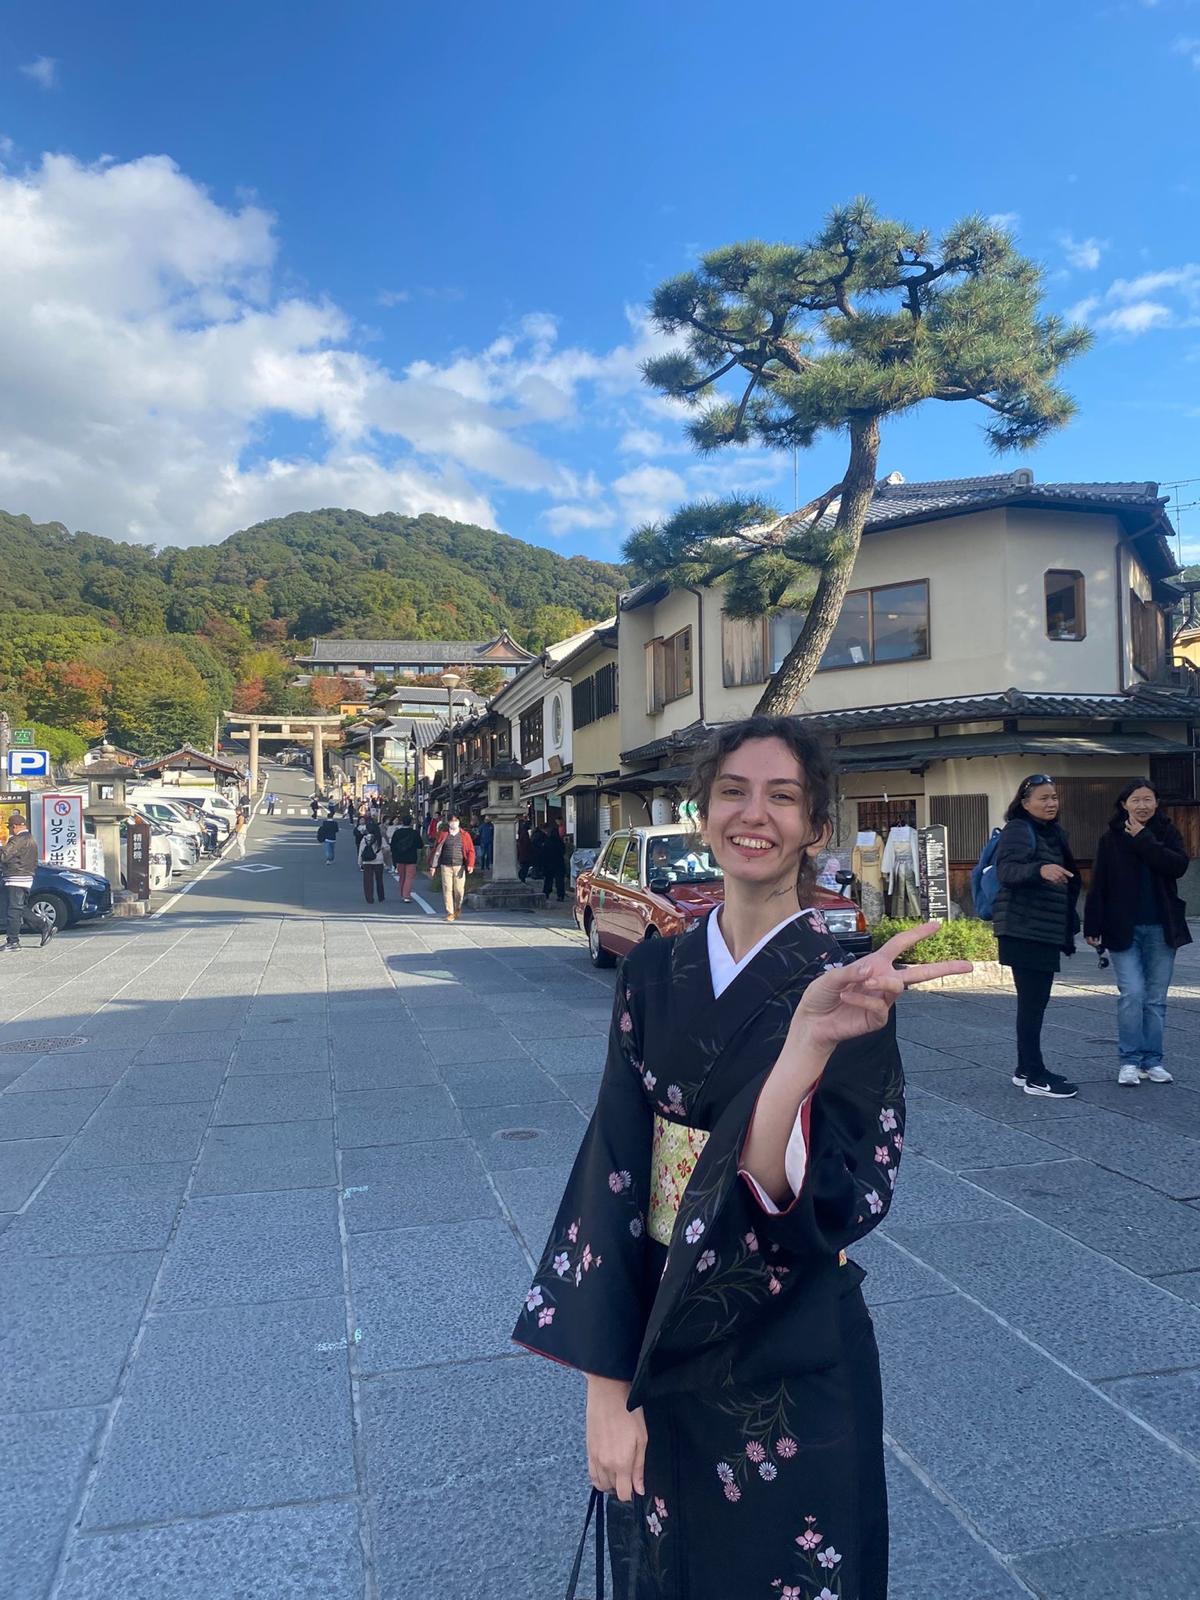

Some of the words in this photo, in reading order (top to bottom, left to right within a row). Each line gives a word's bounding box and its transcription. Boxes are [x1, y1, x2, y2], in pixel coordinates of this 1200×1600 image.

[14, 730, 32, 744] 空
[11, 752, 45, 774] P
[66, 825, 77, 846] この先
